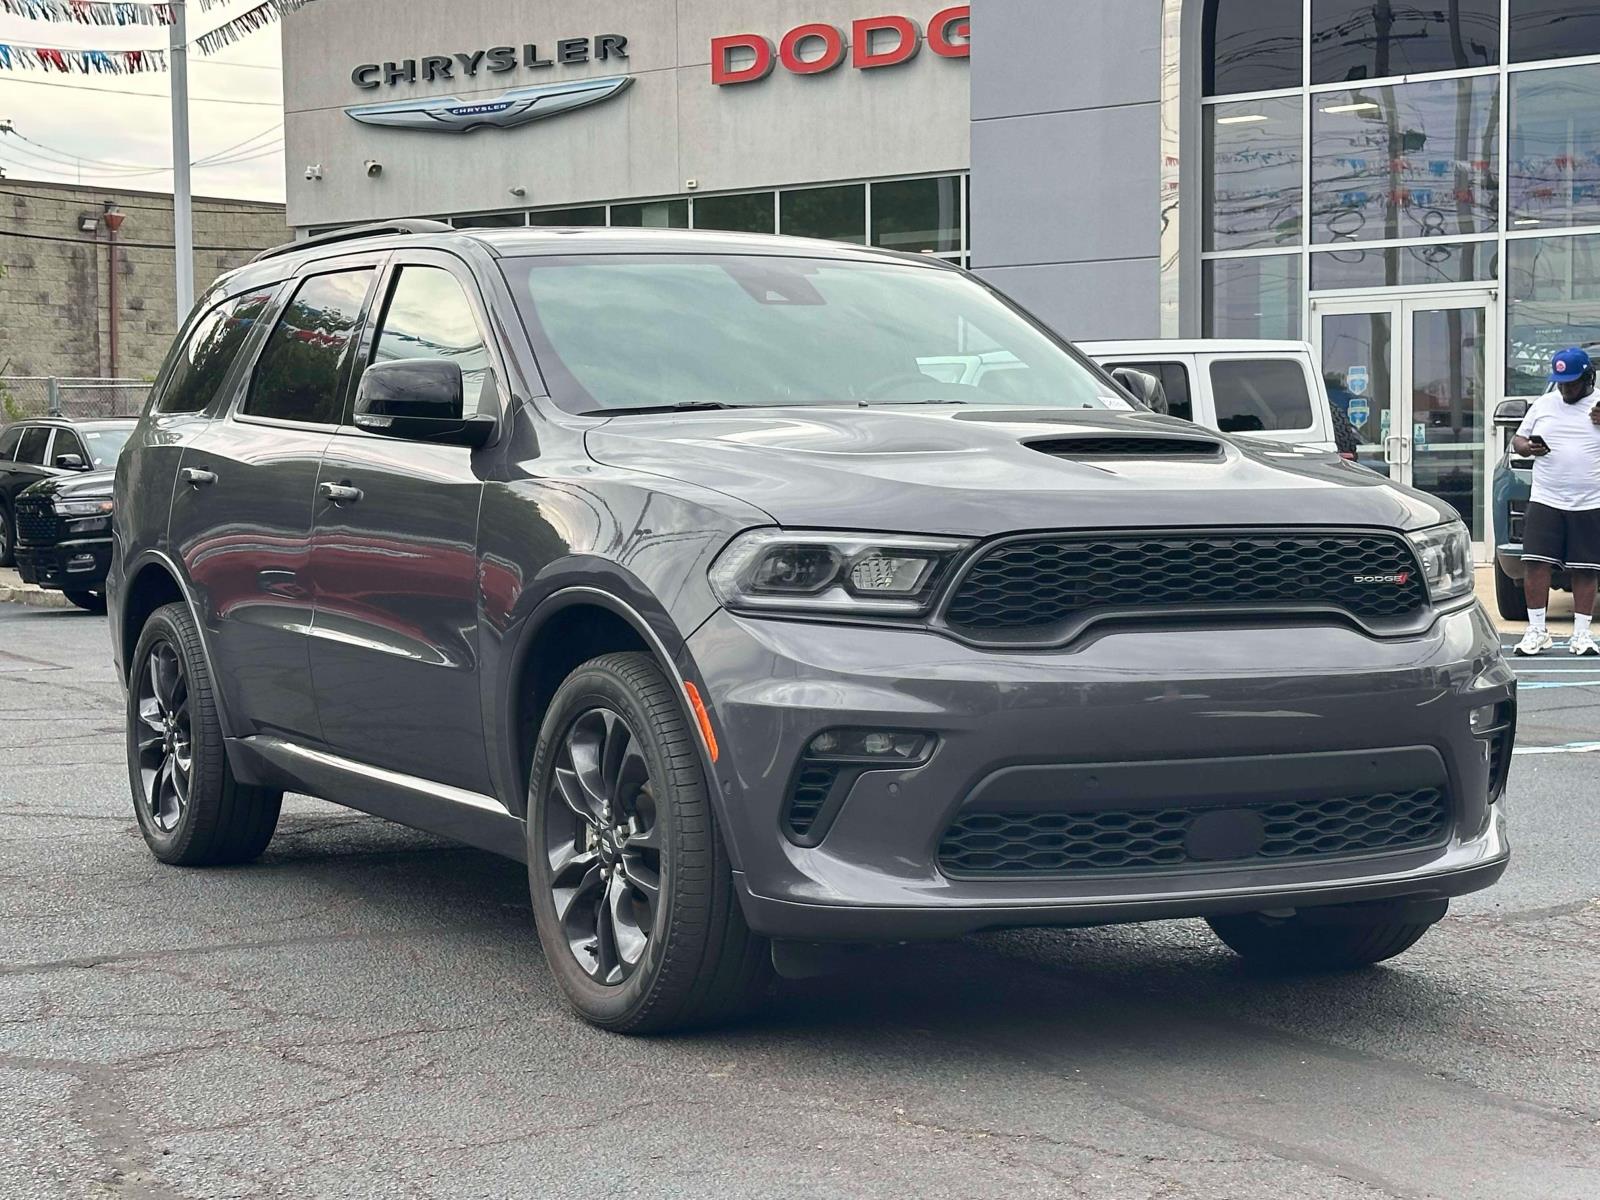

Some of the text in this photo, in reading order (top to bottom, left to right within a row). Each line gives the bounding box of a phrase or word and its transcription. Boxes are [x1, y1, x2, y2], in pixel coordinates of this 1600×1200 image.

[351, 33, 629, 89] CHRYSLER
[452, 104, 507, 114] CHRYSLER
[1353, 575, 1403, 583] DODGE
